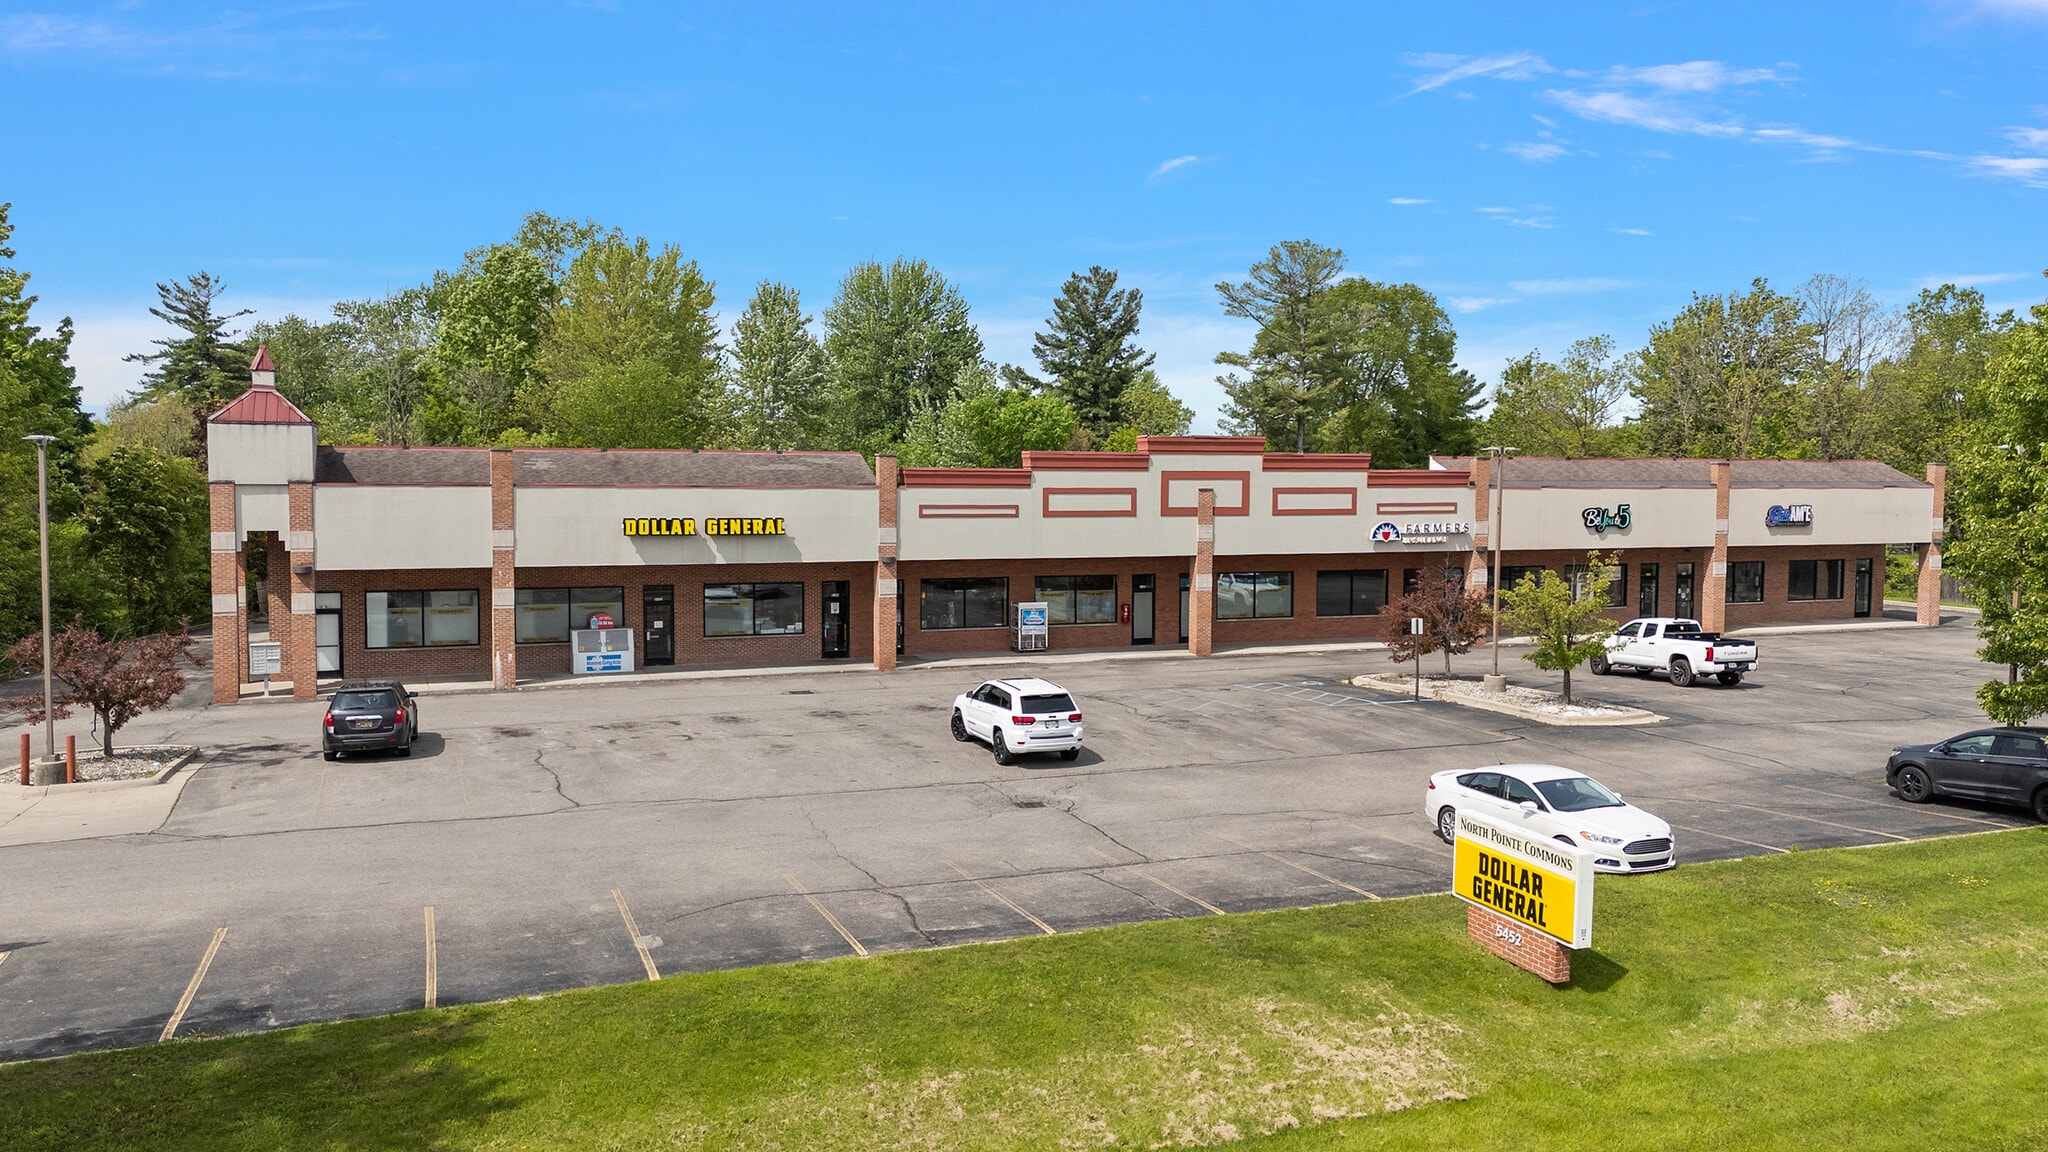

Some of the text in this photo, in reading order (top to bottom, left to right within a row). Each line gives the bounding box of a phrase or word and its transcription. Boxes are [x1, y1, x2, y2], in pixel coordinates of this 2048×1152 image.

[624, 518, 785, 536] DOLLAR GENERAL
[1405, 522, 1470, 534] FARMERS
[1460, 817, 1573, 872] NORTH POINTE COMMONS
[1478, 852, 1543, 899] DOLLAR
[1473, 875, 1546, 928] GENERAL
[1495, 925, 1523, 947] 5452
